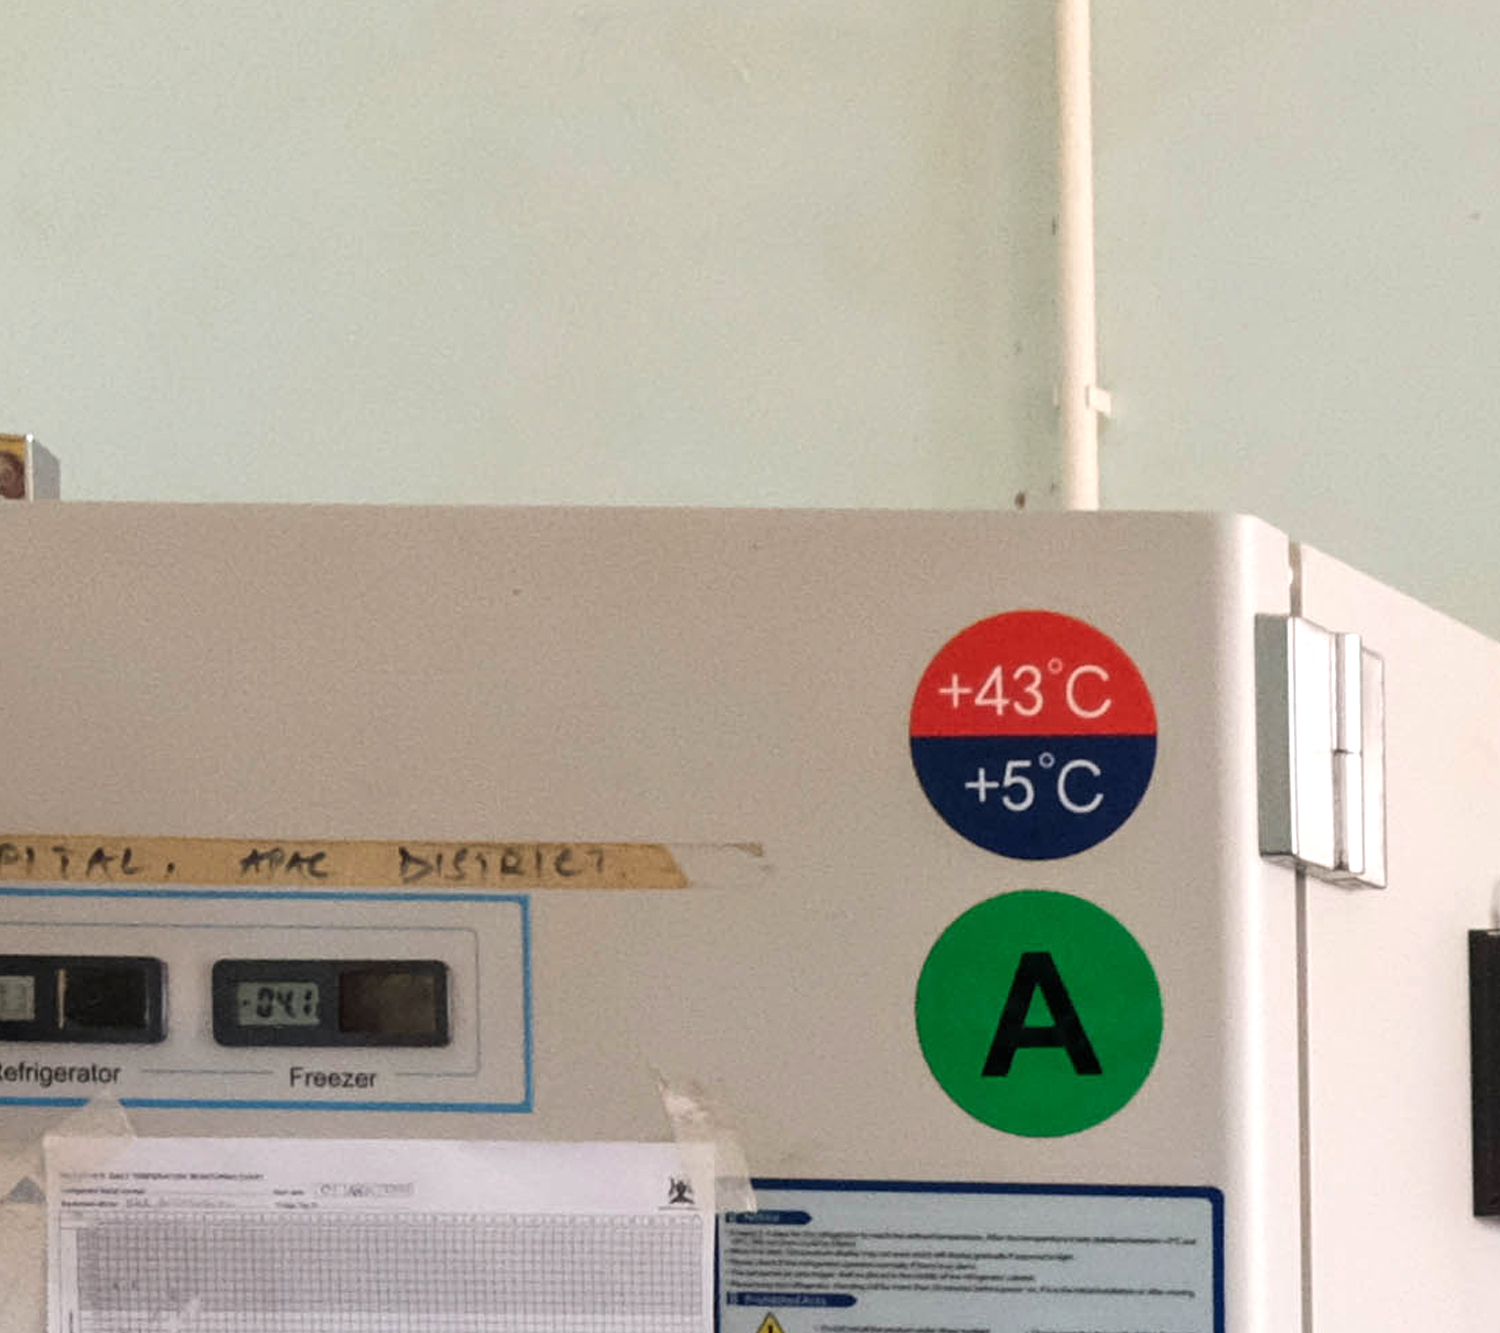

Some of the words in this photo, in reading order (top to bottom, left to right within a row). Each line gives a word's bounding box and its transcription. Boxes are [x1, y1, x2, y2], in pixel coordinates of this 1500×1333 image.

[981, 951, 1103, 1077] A
[0, 1061, 121, 1087] efrigerator
[290, 1066, 377, 1088] Freezer
